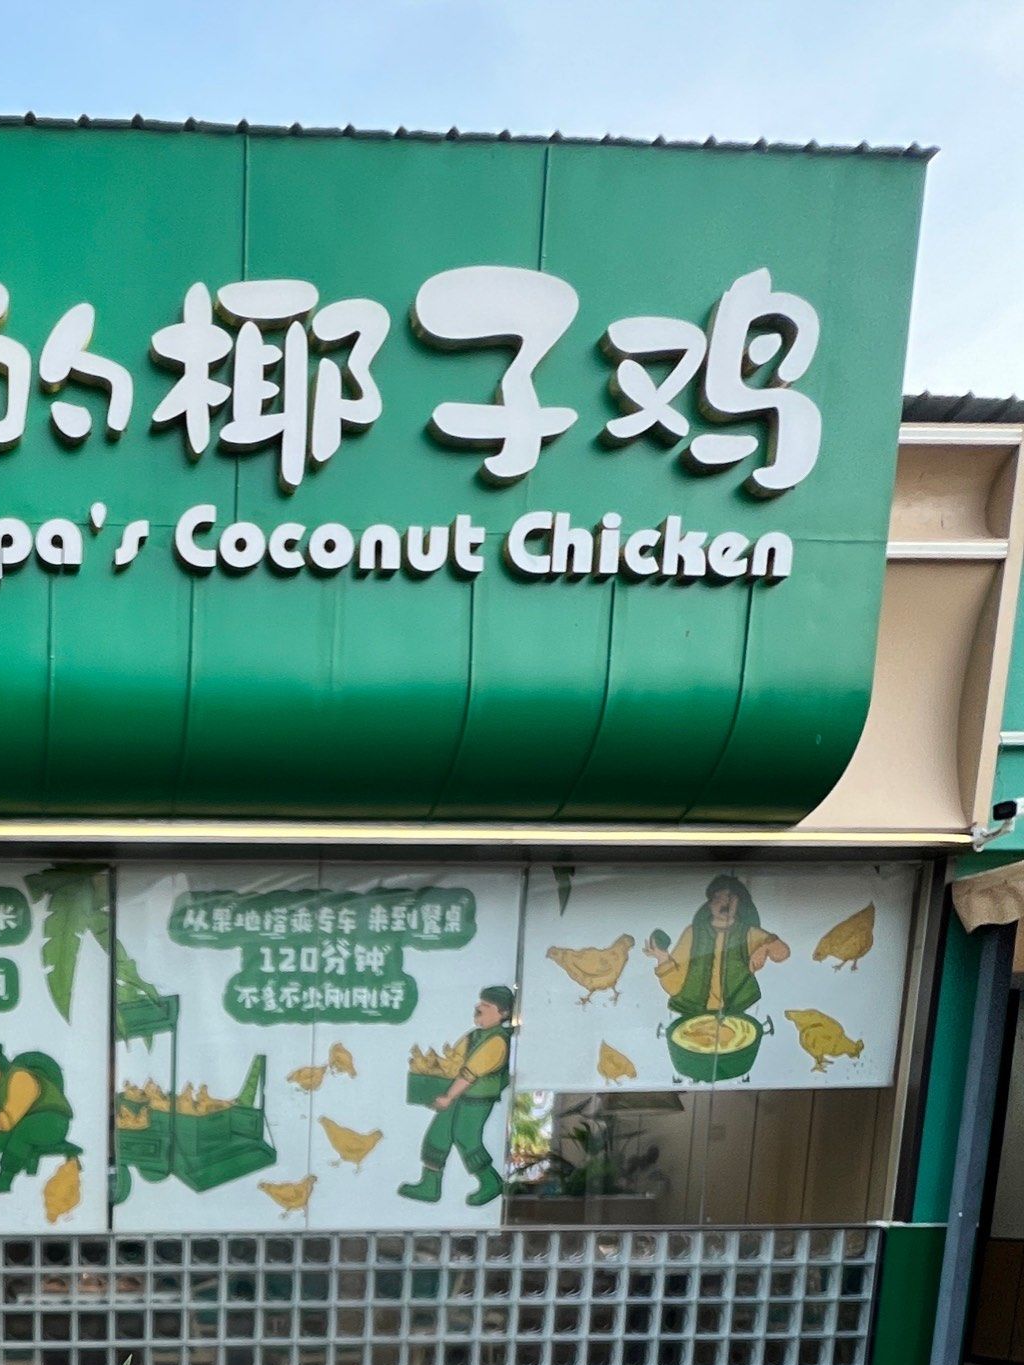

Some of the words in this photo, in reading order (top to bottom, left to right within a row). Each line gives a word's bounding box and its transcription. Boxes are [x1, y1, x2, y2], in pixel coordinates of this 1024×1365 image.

[174, 503, 487, 573] Coconut
[507, 510, 794, 578] Chicken
[259, 938, 387, 976] 120分钟
[235, 980, 405, 1011] 不多不少刚刚好
